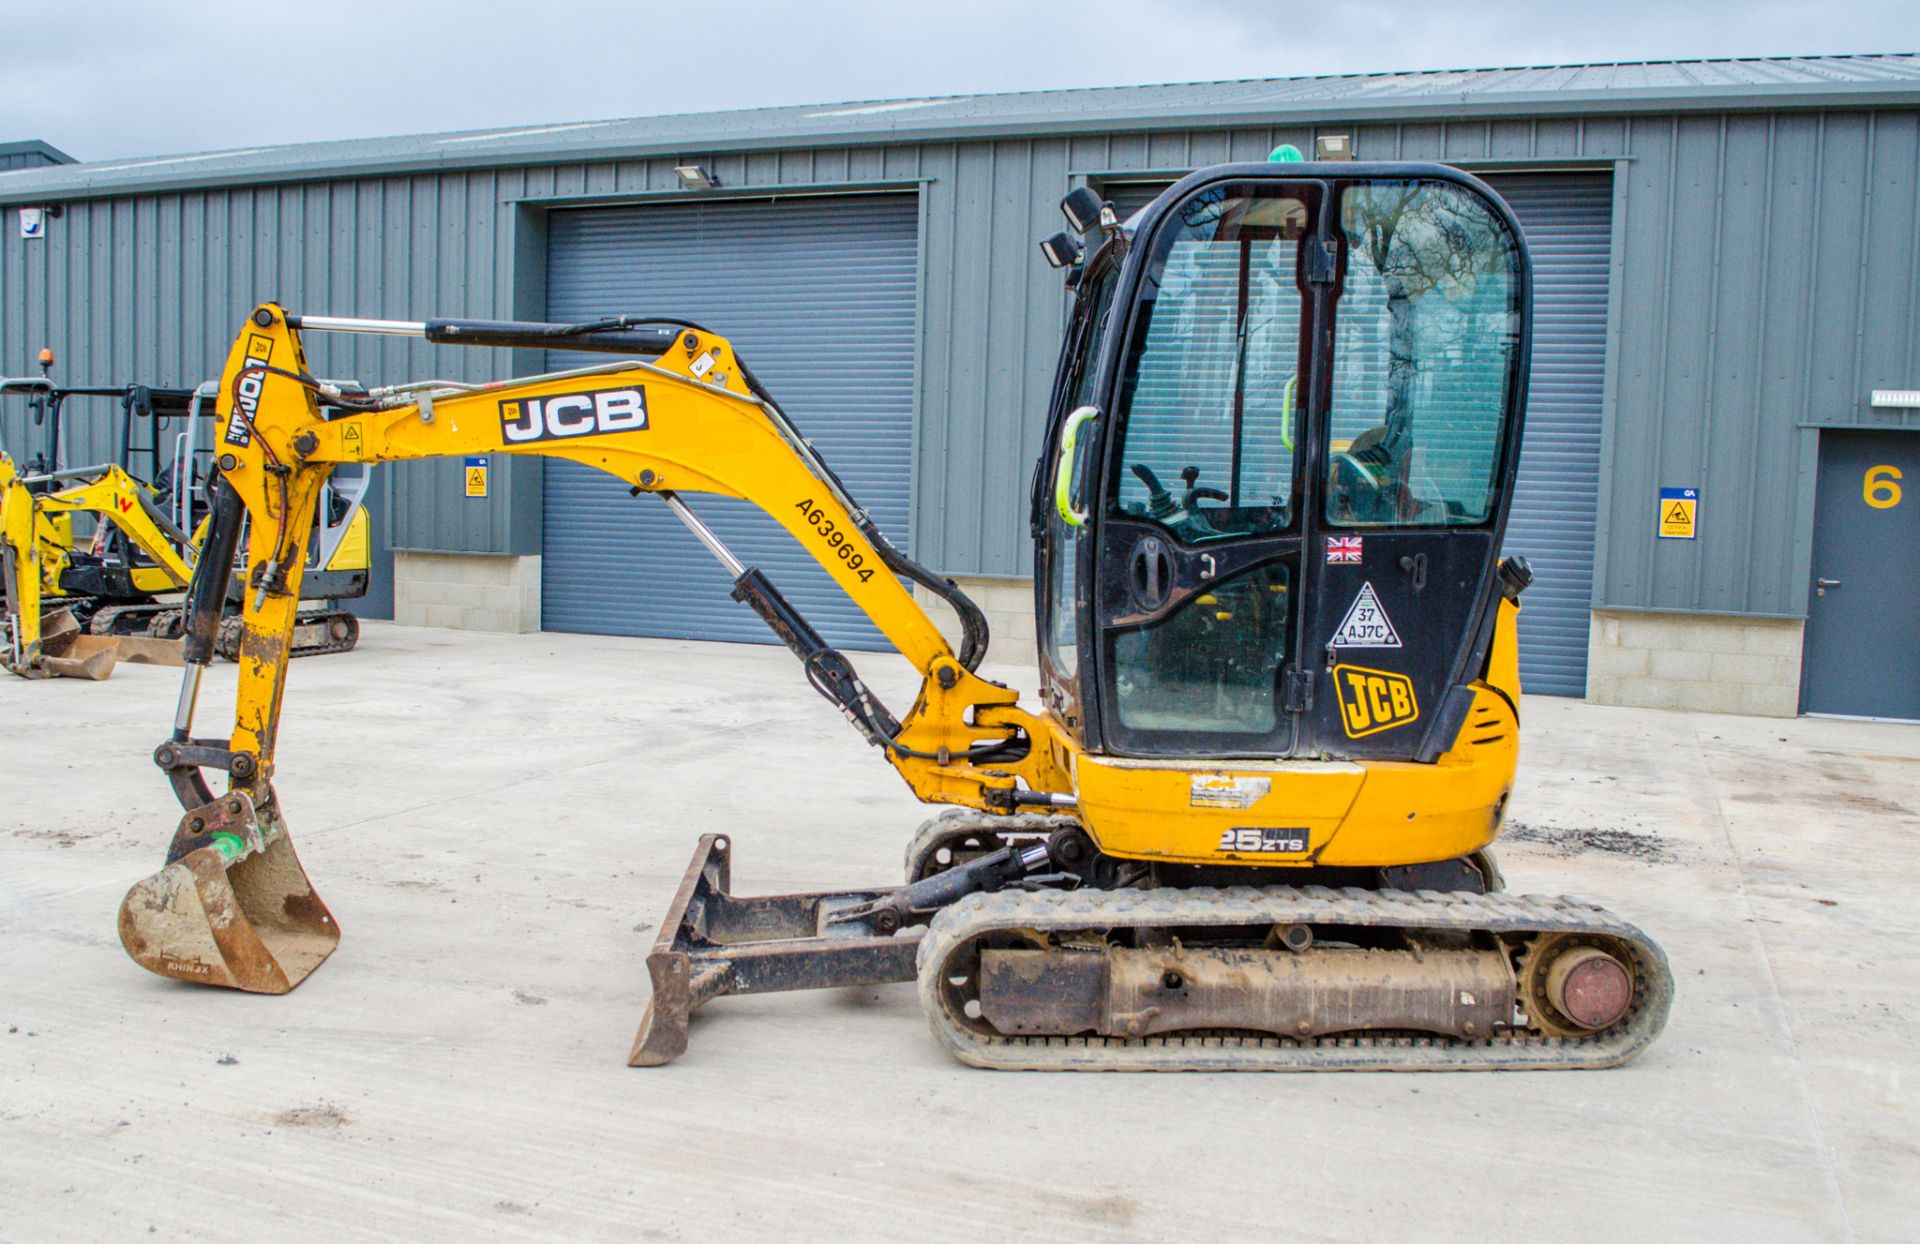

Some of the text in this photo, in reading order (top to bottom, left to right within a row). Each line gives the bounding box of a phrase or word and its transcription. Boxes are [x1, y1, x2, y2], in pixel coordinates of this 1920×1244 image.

[504, 389, 646, 441] JCB
[1863, 465, 1903, 509] 6
[795, 498, 875, 583] A639694
[1348, 625, 1383, 638] AJ7C
[1358, 608, 1375, 621] 37
[1346, 672, 1411, 730] JCB
